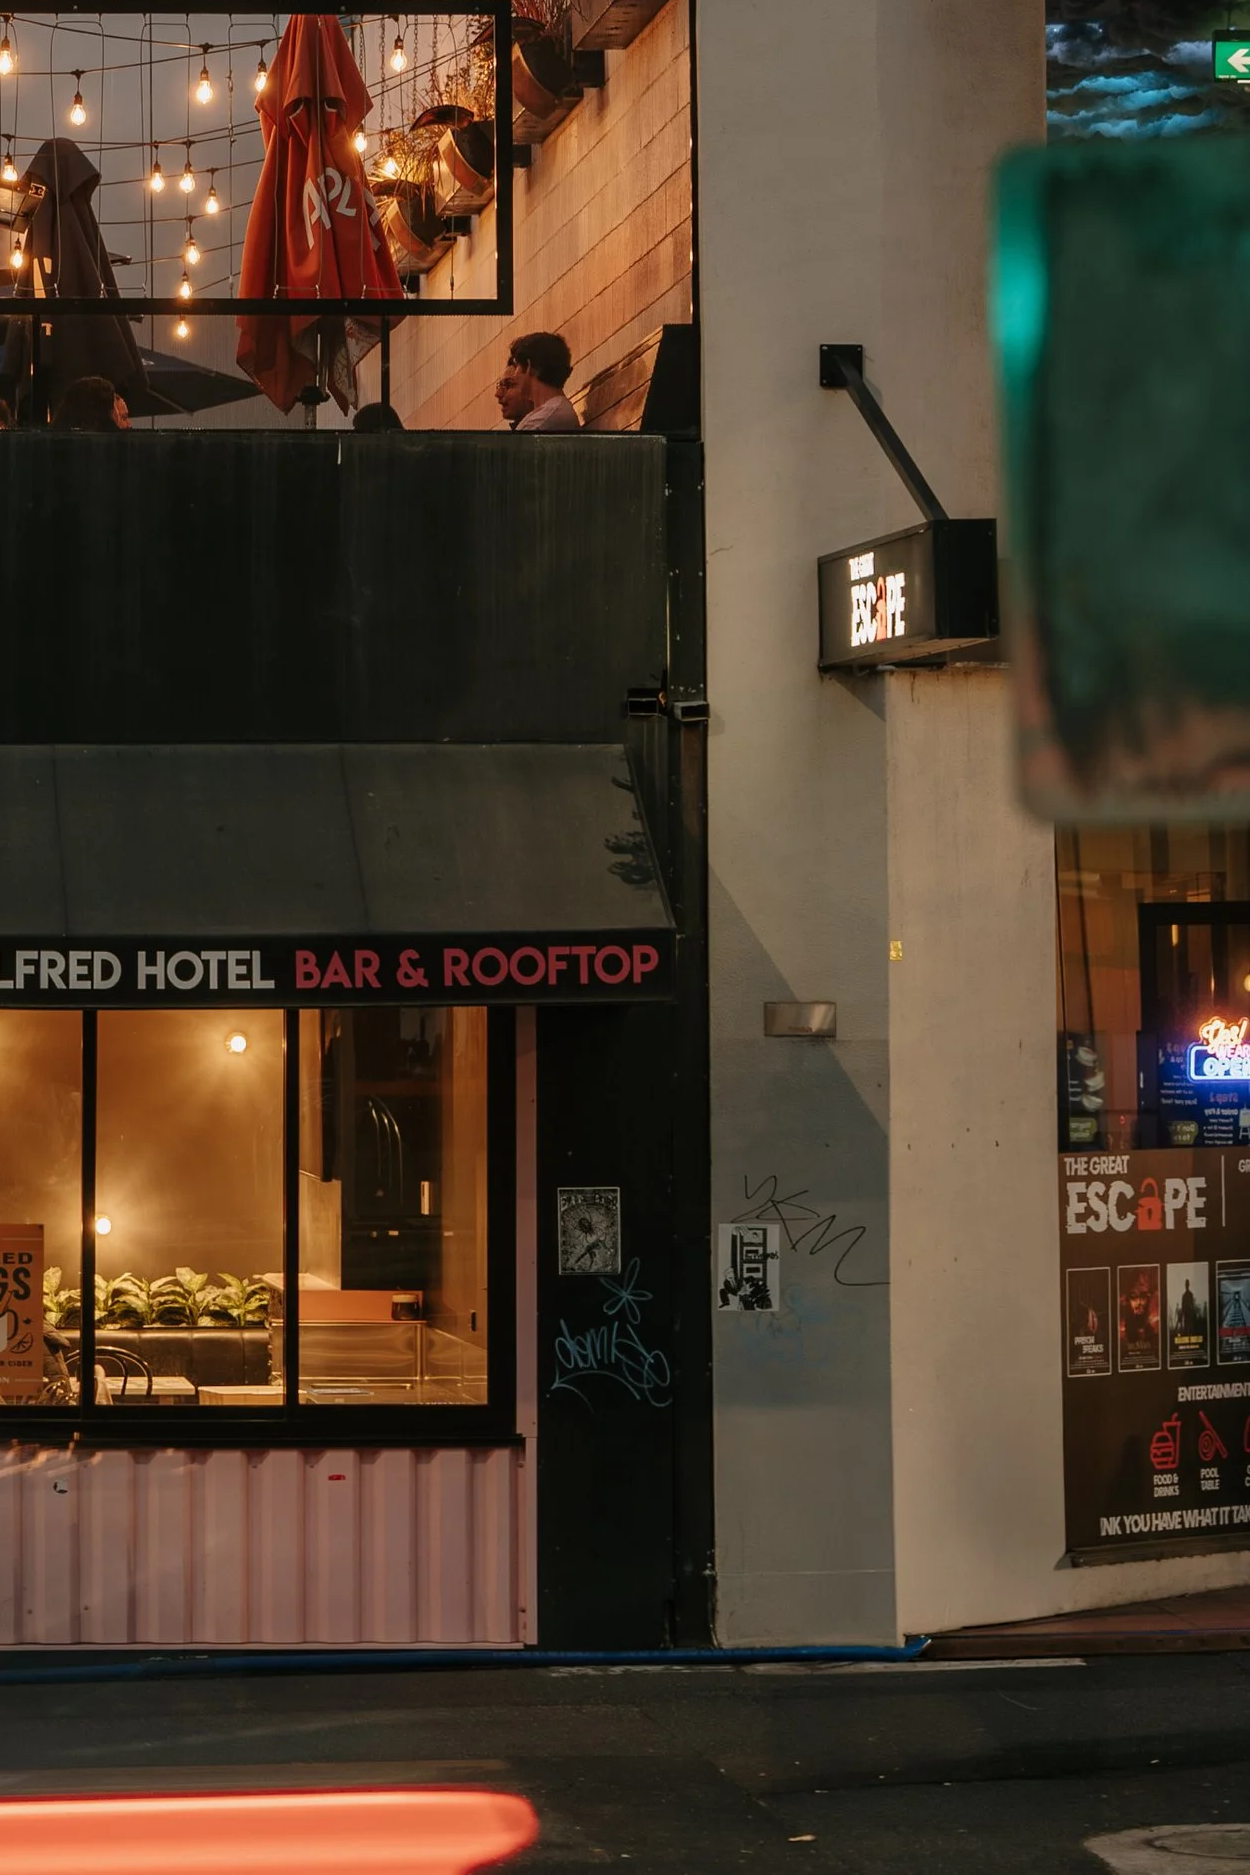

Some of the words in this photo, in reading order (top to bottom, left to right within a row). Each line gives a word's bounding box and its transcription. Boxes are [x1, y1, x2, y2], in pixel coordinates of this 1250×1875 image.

[851, 572, 905, 647] ESCAPE
[137, 950, 275, 989] HOTEL
[295, 950, 381, 988] BAR
[396, 949, 429, 987] &
[443, 945, 659, 987] ROOFTOP
[1064, 1157, 1089, 1176] THE
[1089, 1155, 1130, 1175] GREAT
[1065, 1177, 1207, 1235] ESCAPE
[7, 1359, 33, 1368] CIDER
[1153, 1474, 1173, 1486] FOOD
[1173, 1473, 1179, 1485] &
[1200, 1467, 1219, 1480] POOL
[1153, 1485, 1180, 1498] DRINKS
[1200, 1479, 1220, 1491] TABLE
[1123, 1513, 1152, 1534] YOU
[1151, 1511, 1182, 1532] HAVE
[1183, 1508, 1218, 1529] WHAT
[1219, 1506, 1230, 1525] IT
